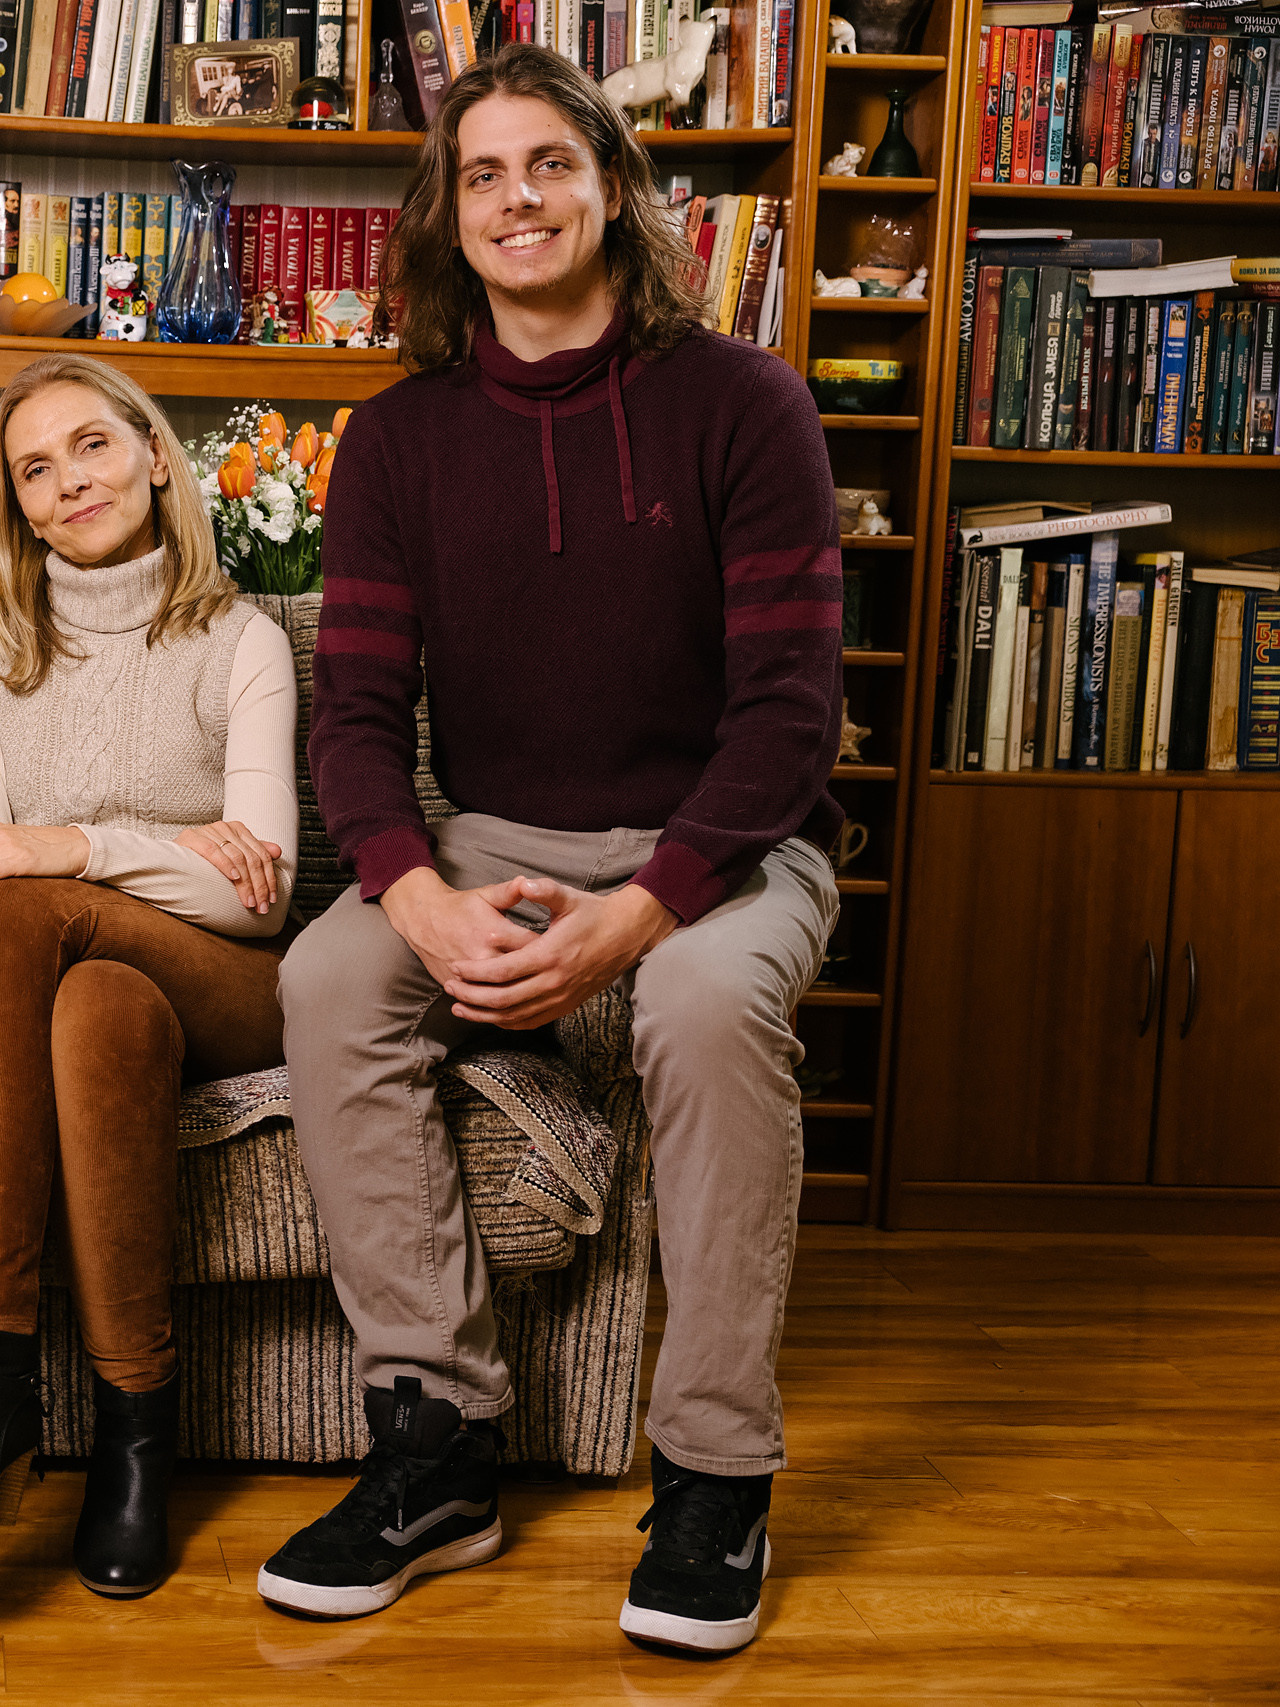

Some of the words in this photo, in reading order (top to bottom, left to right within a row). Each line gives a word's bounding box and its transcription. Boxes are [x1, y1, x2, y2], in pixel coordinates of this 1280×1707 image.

[778, 10, 790, 45] АНГЕЛ
[1245, 25, 1276, 34] РОМАН
[73, 28, 91, 79] ПОРТРЕТ
[118, 34, 132, 80] БАЛАШОВ
[139, 36, 152, 81] БАЛАШОВ
[759, 26, 771, 73] БАЛАШОВ
[992, 35, 1001, 73] БУШКОВ
[1025, 36, 1034, 70] БУШКОВ
[1071, 54, 1079, 78] БУШКОВ
[776, 46, 788, 94] ЧЕРНЫЙ
[991, 74, 998, 84] А.
[1025, 71, 1032, 80] А.
[1172, 58, 1183, 95] ПОСЛЕДНЯЯ
[1190, 60, 1201, 87] ПУТЬ
[757, 75, 769, 122] ДМИТРИЙ
[1169, 95, 1179, 127] КРЕПОСТЬ
[1190, 88, 1197, 96] К
[1207, 89, 1219, 123] ПОРОГА
[1185, 98, 1197, 137] ПОРОГУ
[1000, 115, 1013, 165] БУШКОВ
[1034, 119, 1042, 158] СВАРОГ
[1050, 127, 1058, 163] СВАРОГ
[1120, 121, 1133, 170] БУШКОВ
[1204, 125, 1215, 170] БРАТСТВО
[1000, 166, 1010, 178] А.
[1120, 172, 1130, 184] А.
[88, 247, 99, 257] III
[286, 237, 300, 291] А.ДЮМА
[959, 257, 977, 342] АМОСОВА
[1044, 336, 1059, 379] ЗМЕЯ
[1083, 347, 1091, 374] ВОЛК
[1039, 380, 1057, 442] КОЛЬЦА
[1081, 375, 1090, 411] БЕЛЫЙ
[1161, 373, 1180, 445] ЛУКЬЯНЕНКО
[1046, 509, 1150, 534] PHOTOGRAPHY
[979, 560, 993, 603] Essential
[1169, 587, 1180, 627] GAUGUIN
[1067, 615, 1081, 655] SIGNS
[1090, 580, 1110, 691] IMPRESSIONISTS
[1062, 662, 1078, 722] SYMBOLS
